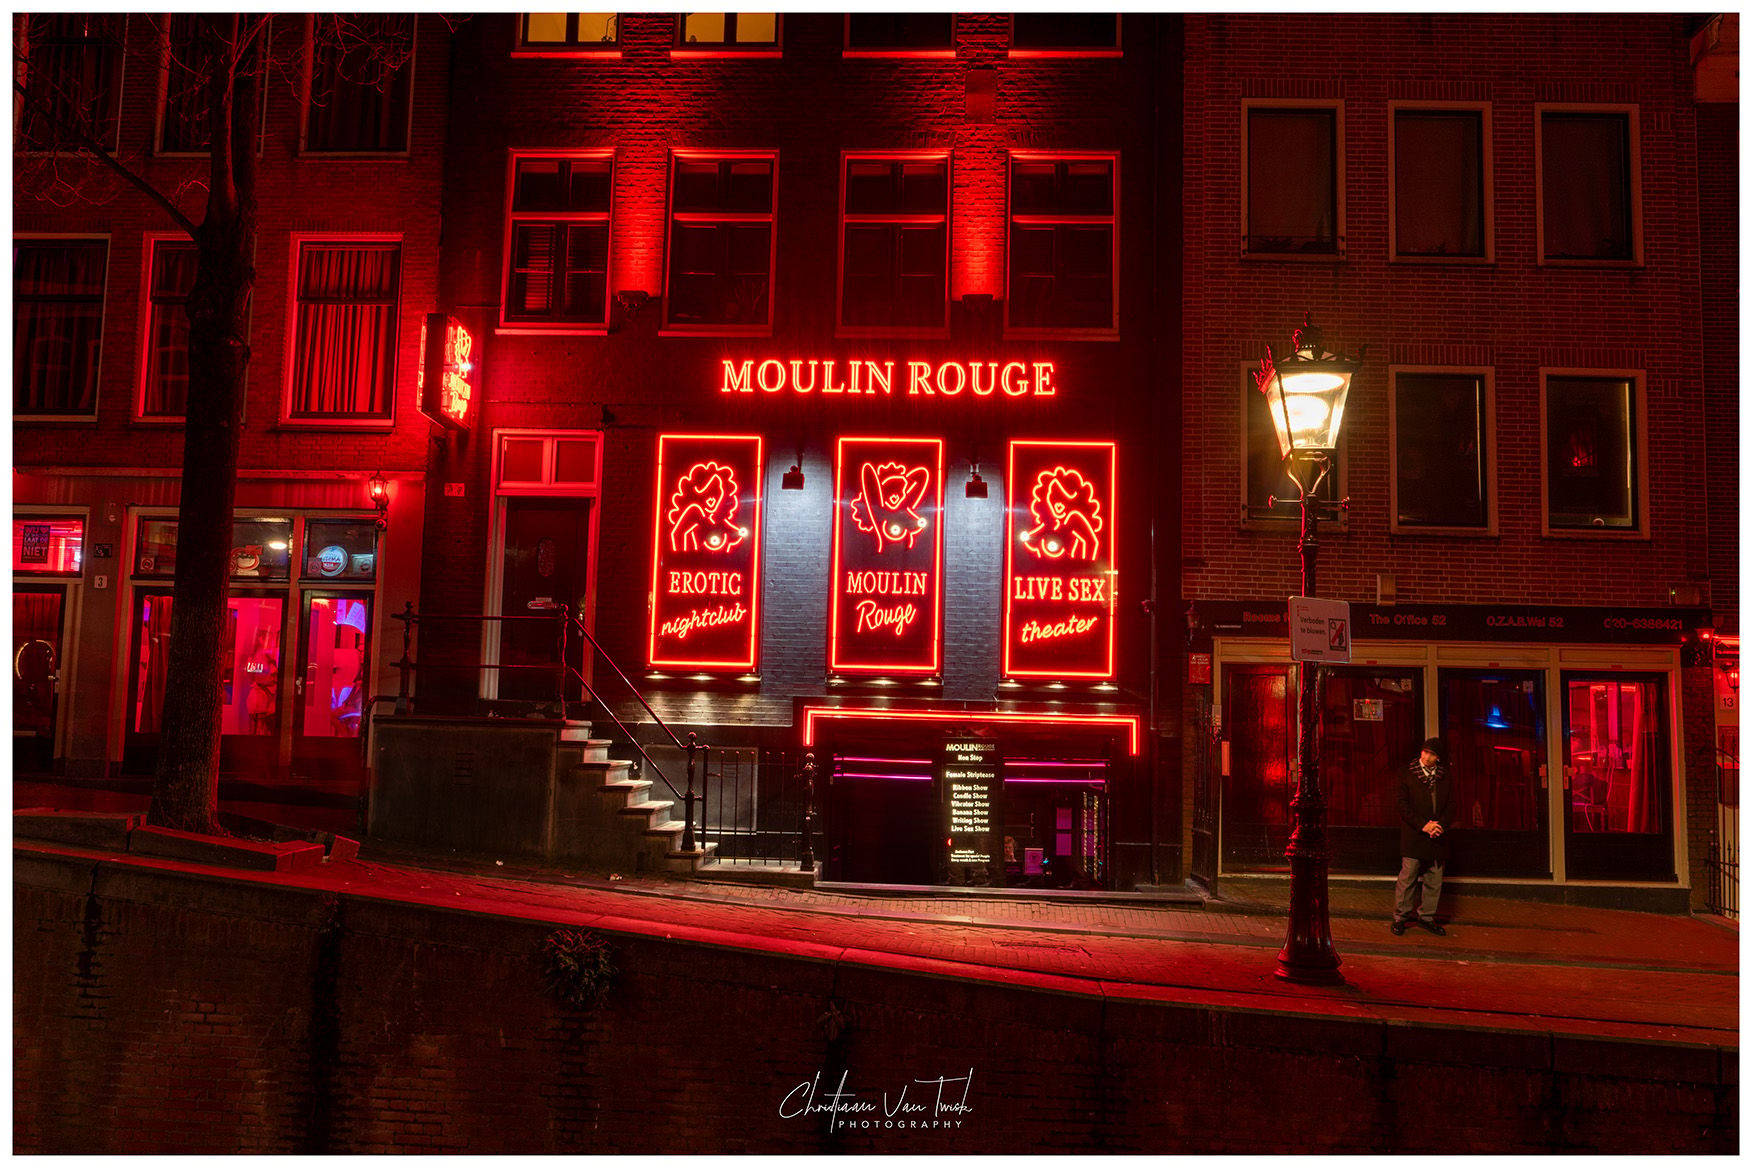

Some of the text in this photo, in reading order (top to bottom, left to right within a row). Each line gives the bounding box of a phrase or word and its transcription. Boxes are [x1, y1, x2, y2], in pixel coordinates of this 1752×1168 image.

[721, 360, 1056, 396] MOULIN ROUGE
[23, 546, 48, 557] NIET
[97, 576, 104, 588] 3
[668, 571, 742, 596] EROTIC
[846, 571, 928, 595] MOULIN
[1014, 576, 1106, 602] LIVE SEX
[661, 602, 747, 639] nightclub
[856, 600, 917, 636] Rouge
[1243, 611, 1281, 623] Rooms
[1300, 616, 1325, 625] Verboden
[1369, 613, 1447, 626] The Office 52
[1549, 616, 1565, 628] 52
[1021, 614, 1098, 643] theater
[1723, 697, 1734, 708] 13
[945, 743, 978, 751] MOULIN
[970, 754, 983, 762] Stop
[967, 771, 995, 779] Striptease
[952, 817, 973, 825] Writing
